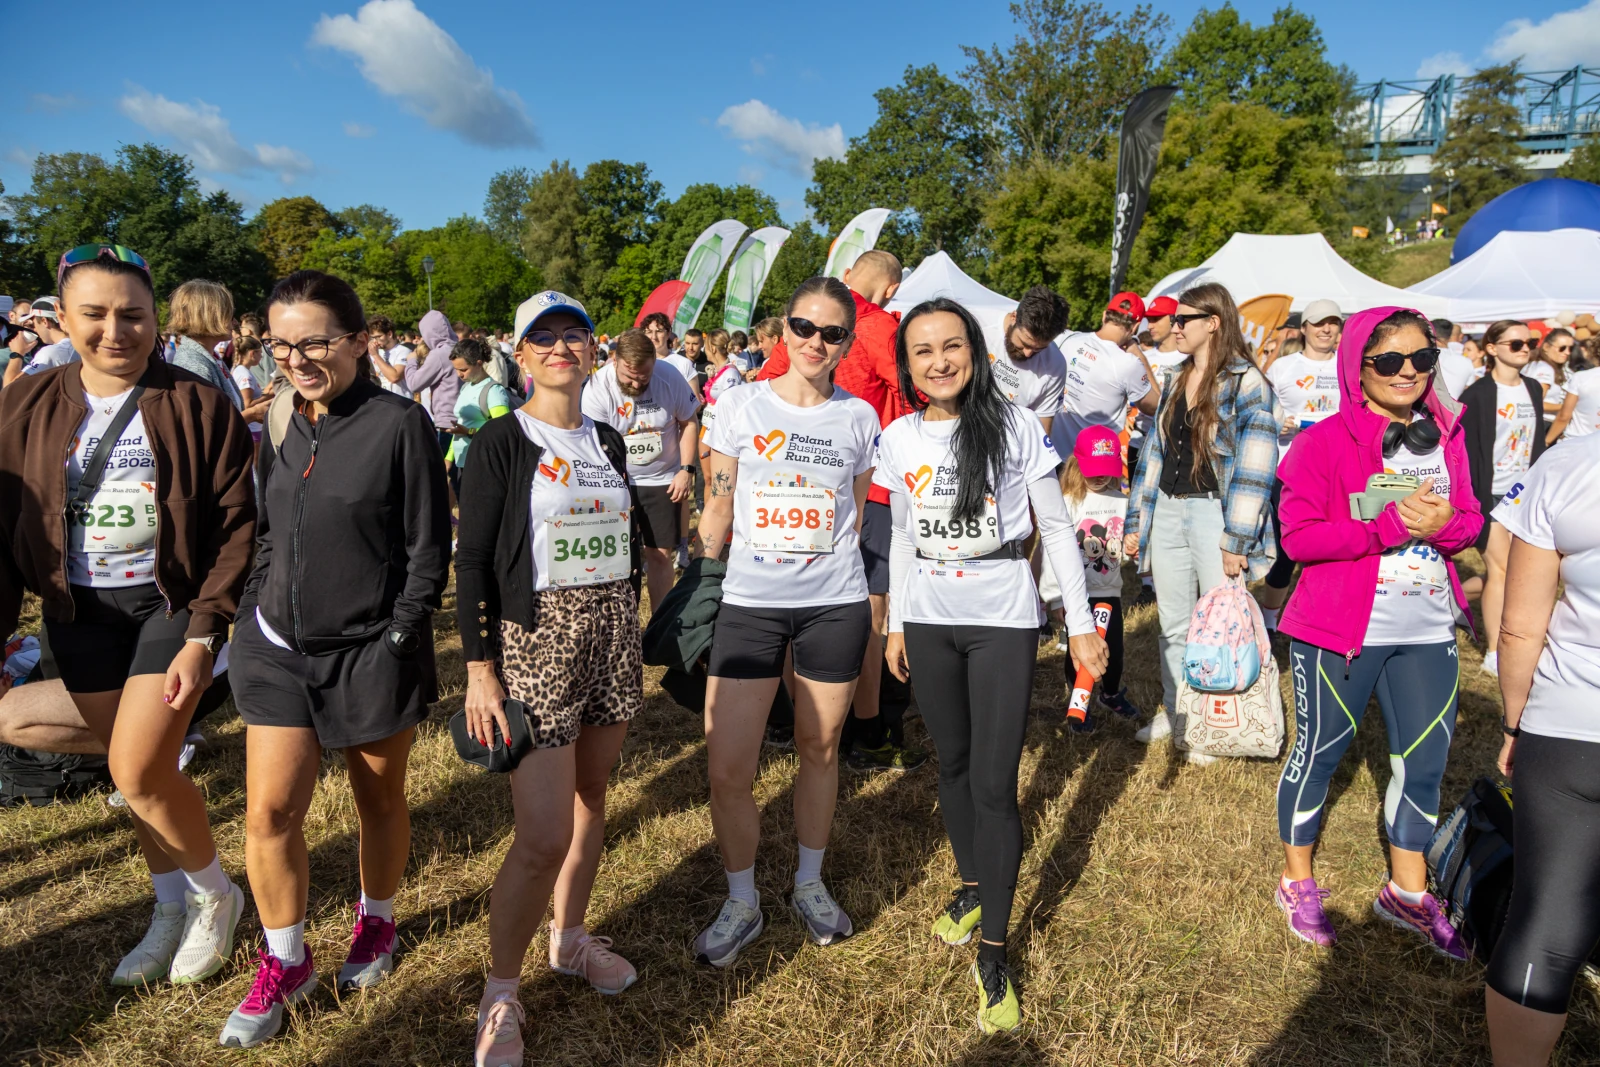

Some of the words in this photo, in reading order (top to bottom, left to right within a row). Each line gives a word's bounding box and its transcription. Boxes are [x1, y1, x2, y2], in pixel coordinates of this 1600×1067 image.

[1084, 351, 1098, 361] UBS
[996, 359, 1019, 375] Poland
[790, 433, 832, 447] Poland
[787, 442, 840, 458] Business
[784, 451, 811, 464] Run
[812, 455, 844, 468] 2026
[1401, 464, 1442, 477] Poland
[577, 478, 602, 488] Run
[931, 486, 957, 497] Run
[144, 504, 156, 514] B
[147, 516, 156, 527] 5
[755, 507, 821, 530] 3498
[825, 509, 834, 519] Q
[825, 521, 833, 531] 2
[918, 518, 983, 539] 3498
[986, 516, 997, 527] Q
[989, 529, 996, 538] 1
[553, 534, 617, 562] 3498
[621, 533, 629, 543] Q
[622, 545, 629, 556] 5
[1293, 651, 1309, 719] KARI
[1207, 715, 1235, 724] Kaufland
[1284, 721, 1309, 784] TRAA
